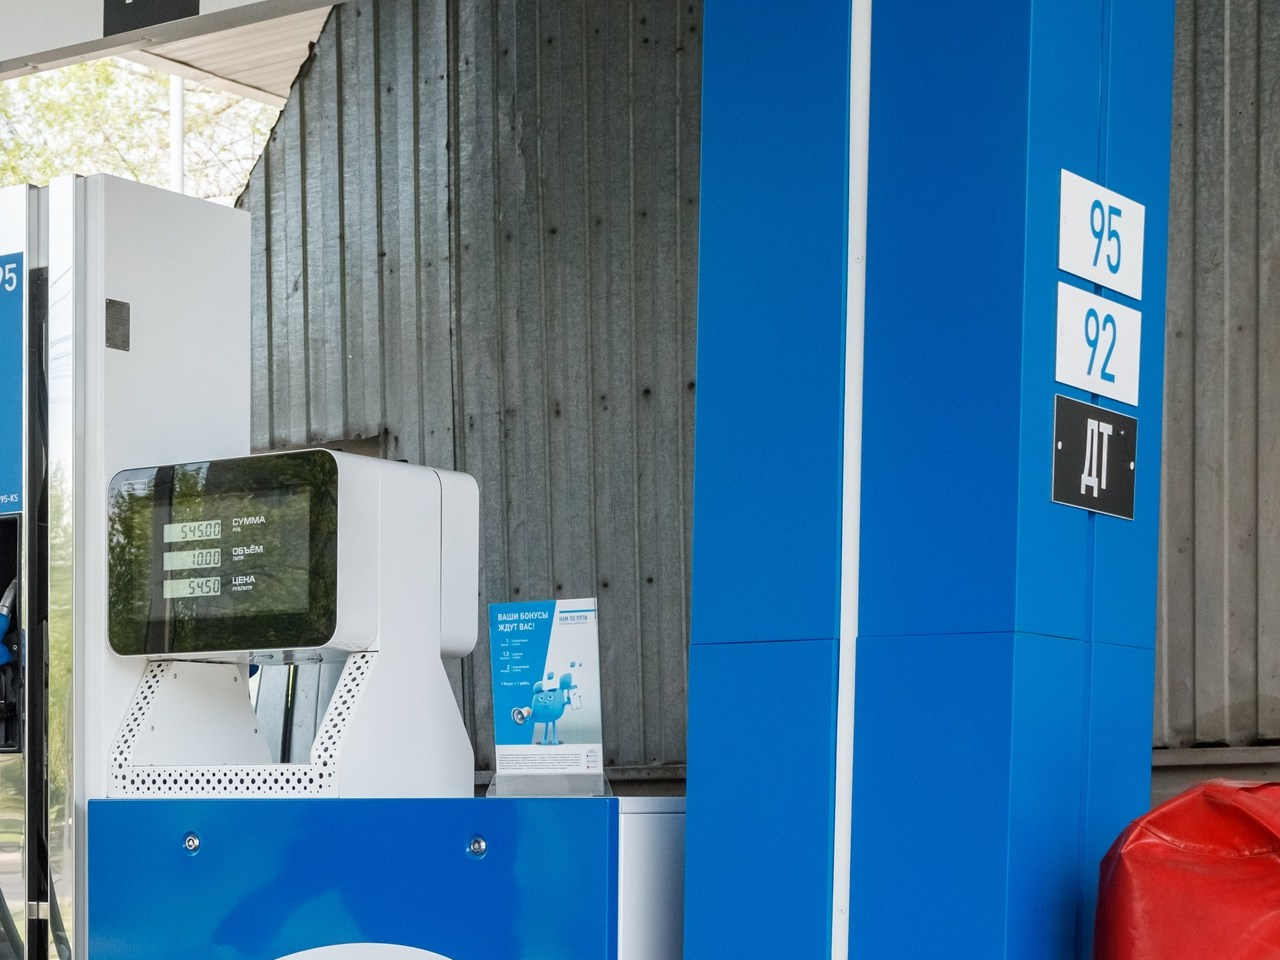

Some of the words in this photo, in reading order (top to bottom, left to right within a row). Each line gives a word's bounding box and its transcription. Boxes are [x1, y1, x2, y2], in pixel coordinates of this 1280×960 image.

[1089, 199, 1122, 275] 95
[1084, 307, 1117, 384] 92
[1080, 418, 1113, 498] ДТ
[232, 516, 266, 526] СУММА
[232, 545, 264, 556] ОБЪЁМ
[232, 575, 256, 585] ЦЕНА
[497, 613, 519, 621] ВАШИ
[520, 611, 549, 620] БОНУСЫ
[498, 623, 518, 632] ЖДУТ
[519, 622, 535, 631] ВАС!
